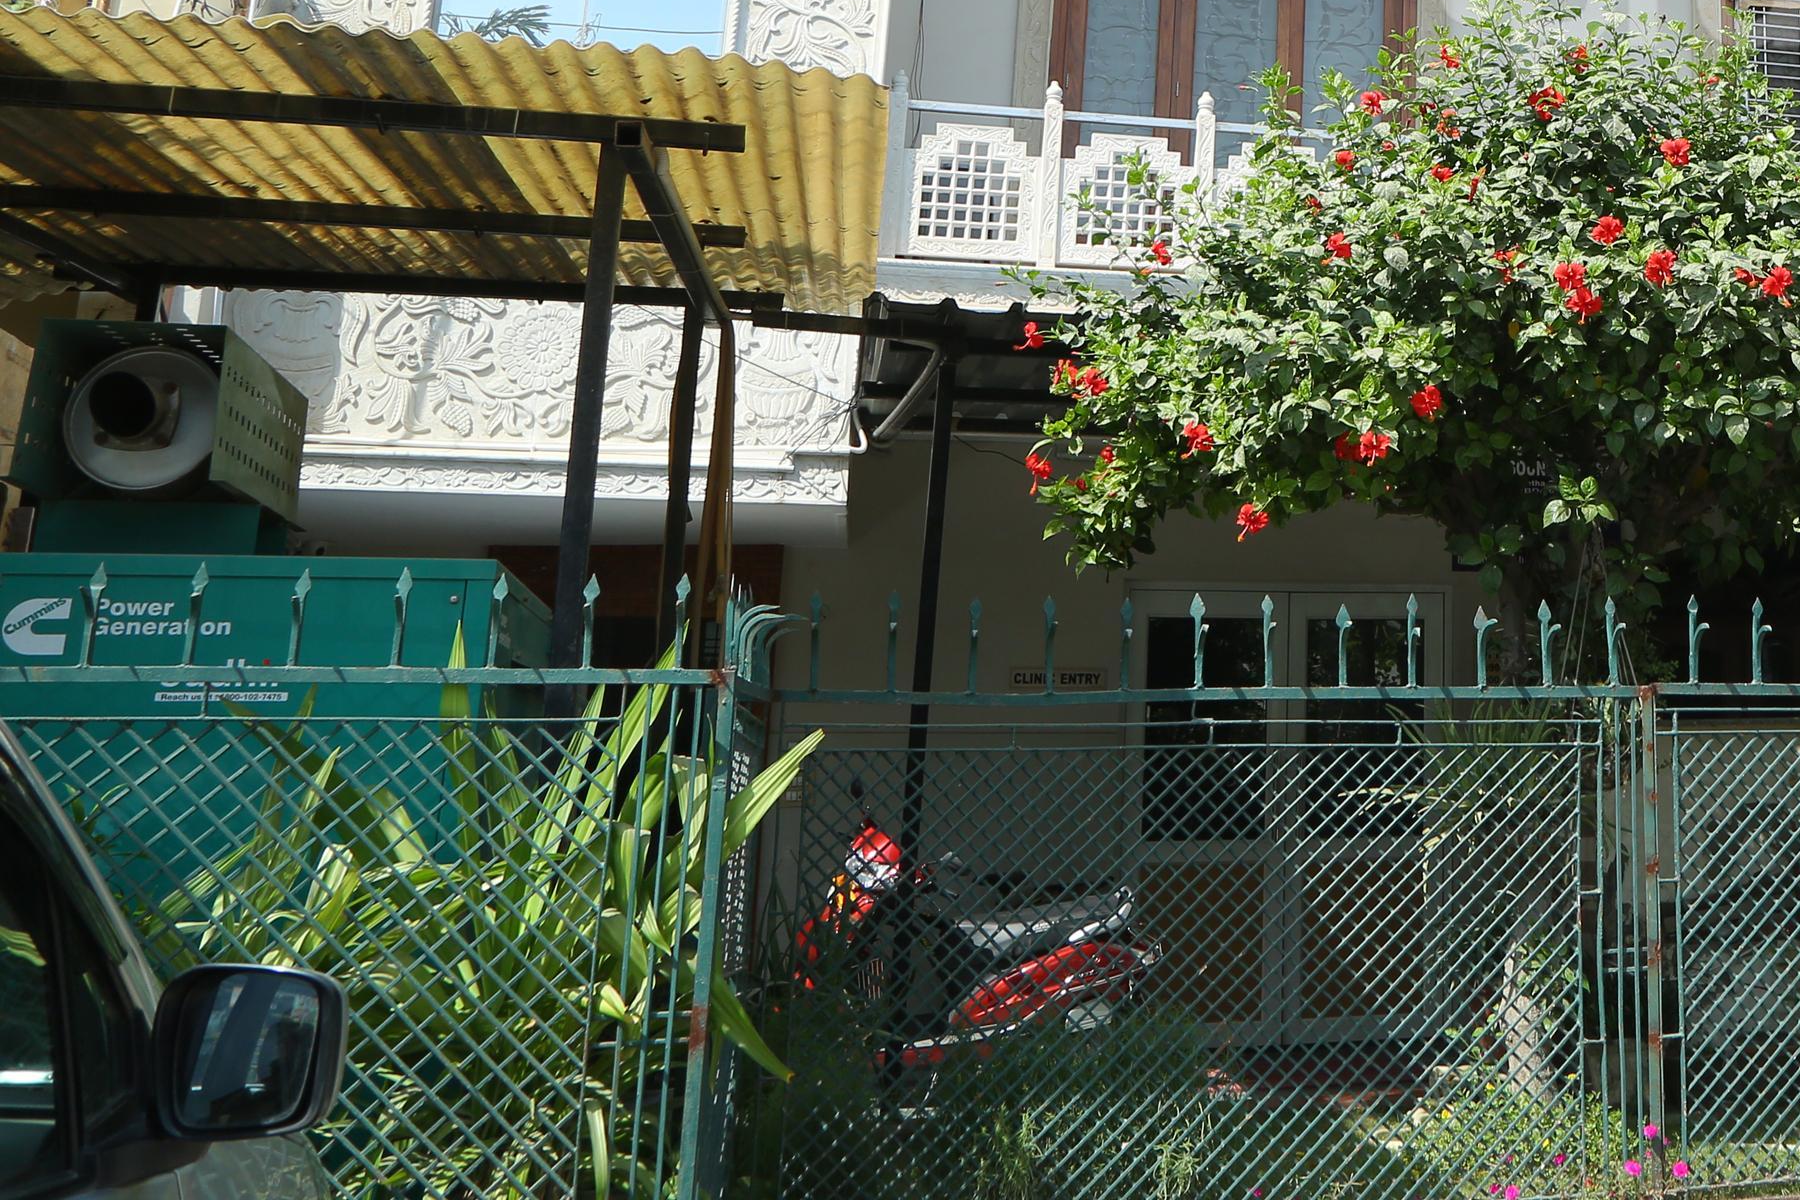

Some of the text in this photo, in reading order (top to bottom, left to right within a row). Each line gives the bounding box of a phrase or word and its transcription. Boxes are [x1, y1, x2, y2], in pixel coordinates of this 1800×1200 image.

[3, 597, 67, 635] Cummins
[96, 598, 174, 616] Power
[95, 617, 231, 636] Generaton
[1014, 673, 1102, 685] CLINI ENTRY
[160, 693, 189, 701] Reach
